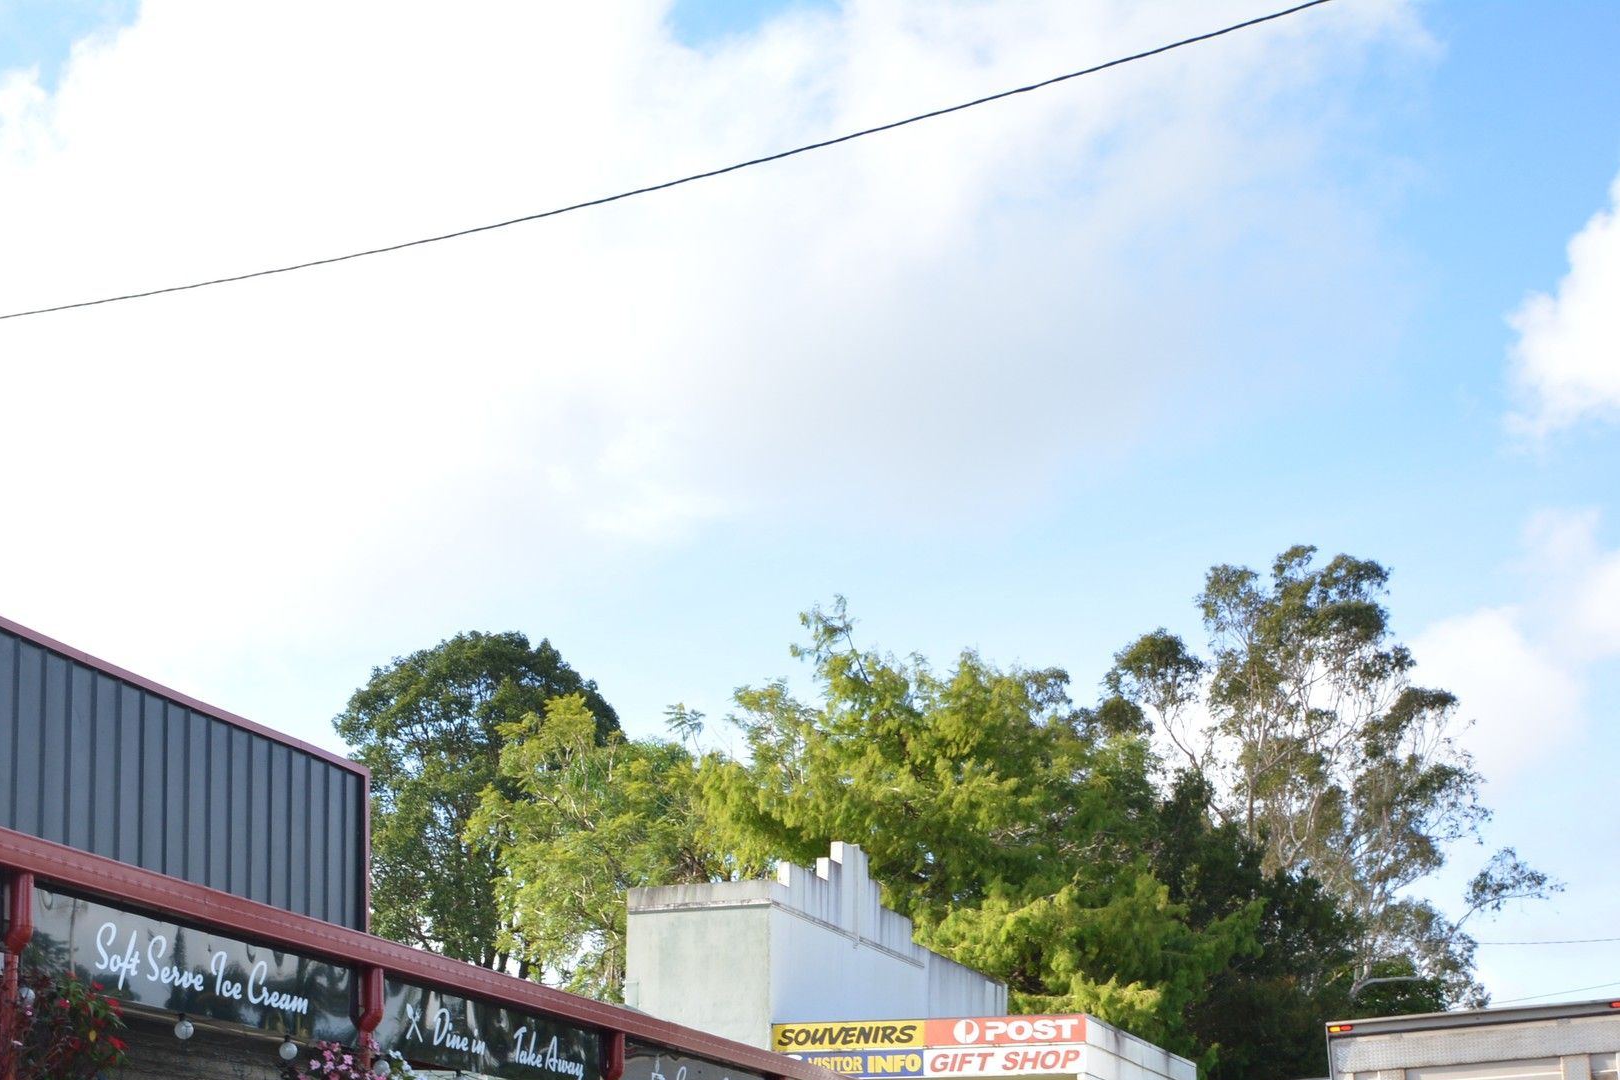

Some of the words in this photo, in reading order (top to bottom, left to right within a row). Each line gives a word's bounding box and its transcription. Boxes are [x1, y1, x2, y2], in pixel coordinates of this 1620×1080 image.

[95, 921, 141, 992] Soft
[147, 935, 204, 992] Serve
[210, 950, 242, 1000] Ice
[247, 961, 309, 1016] Cream
[432, 1008, 469, 1054] Dine
[778, 1024, 917, 1047] SOUVENIRS
[984, 1018, 1079, 1041] POST
[513, 1027, 542, 1070] Take
[867, 1054, 922, 1073] INFO
[930, 1052, 995, 1073] GIFT
[1002, 1050, 1080, 1071] SHOP
